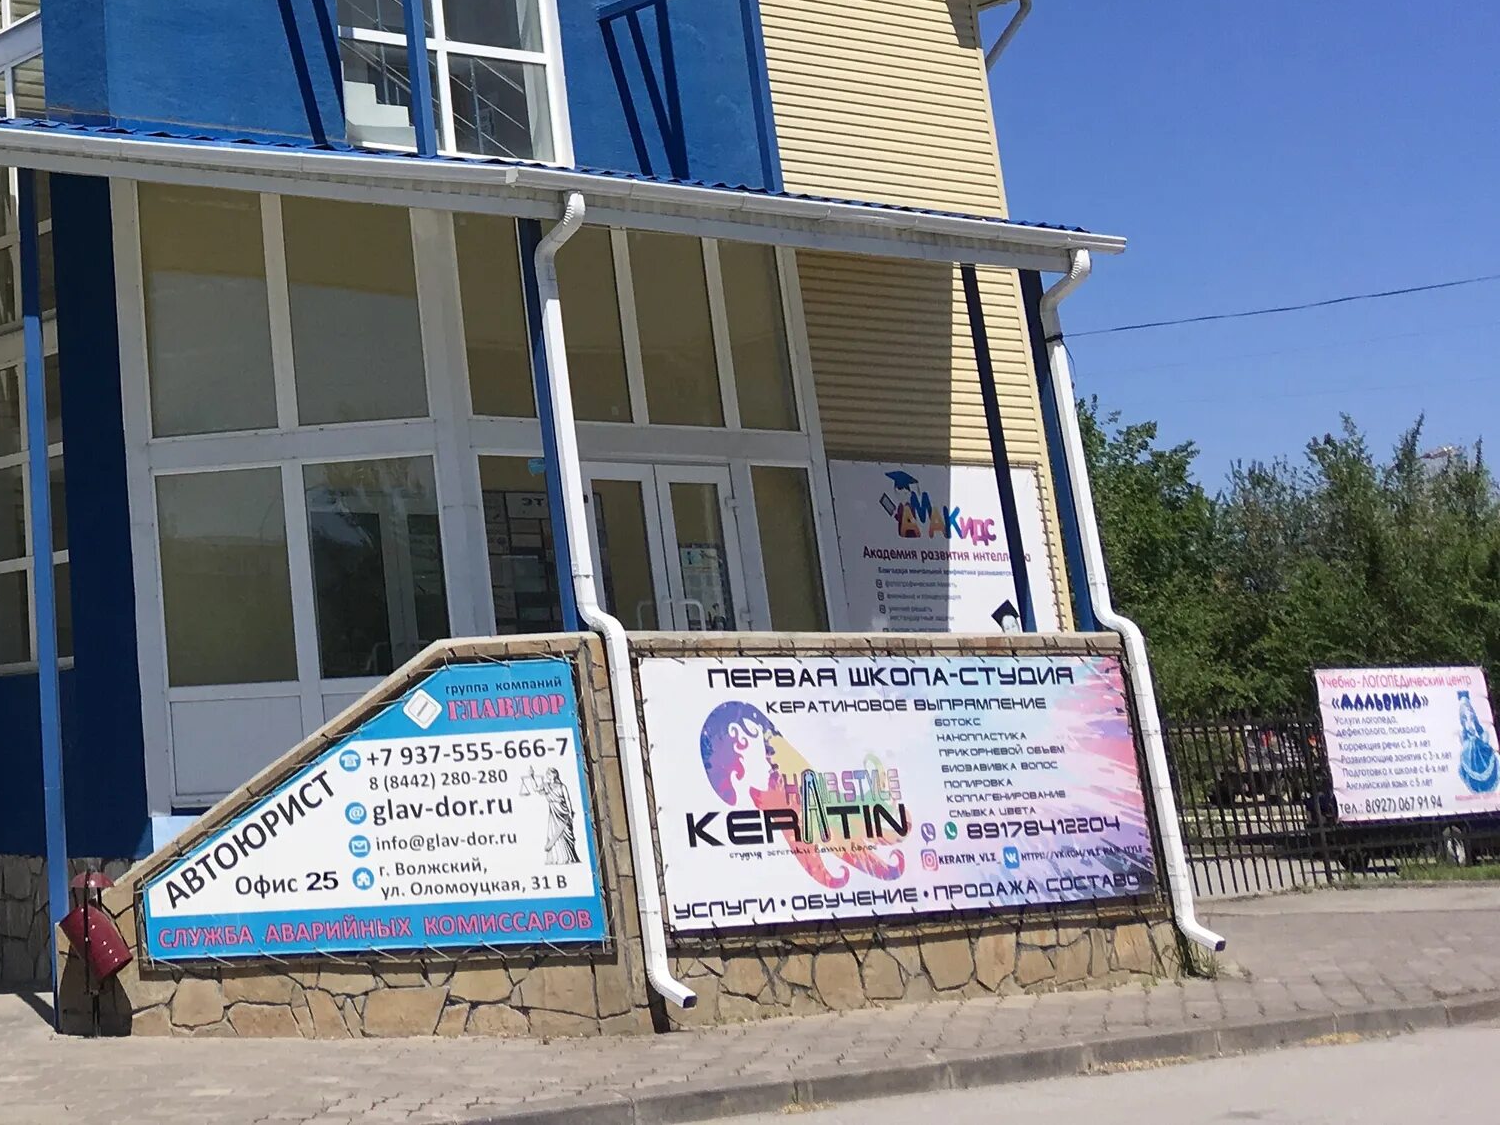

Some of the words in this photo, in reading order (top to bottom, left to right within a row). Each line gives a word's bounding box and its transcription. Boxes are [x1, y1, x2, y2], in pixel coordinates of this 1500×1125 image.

[863, 546, 918, 561] Академия
[921, 550, 970, 563] развития
[445, 684, 489, 696] группа
[496, 676, 562, 691] компаний
[707, 668, 838, 688] ПЕРВАЯ
[849, 666, 1074, 687] ШКОЛА-СТУДИЯ
[447, 693, 566, 721] ГЛАВДОР
[766, 700, 907, 713] КЕРАТИНОВОЕ
[914, 697, 1047, 711] ВЫПРЯМЛЕНИЕ
[934, 718, 981, 727] БОТОКС
[936, 732, 1027, 742] НАНОПЛАСТИКА
[367, 748, 392, 767] +7
[400, 737, 568, 765] 937-555-666-7
[938, 744, 1023, 757] ПРИКОРНЕВОЙ
[1026, 745, 1065, 754] ОБЪЕМ
[941, 763, 1017, 773] БИОЗАВИВКА
[1021, 761, 1059, 770] ВОЛОС
[369, 777, 379, 790] 8
[383, 773, 436, 792] (8442)
[442, 769, 508, 786] 280-280
[944, 779, 1013, 789] ПОЛИРОВКА
[946, 790, 1066, 803] КОЛЛАГЕНИРОВАНИЕ
[1398, 796, 1414, 811] 067
[372, 795, 513, 826] glav-dor.ru
[685, 769, 910, 848] KERATIN
[949, 809, 996, 818] СМЫВКА
[999, 806, 1037, 816] ЦВЕТА
[966, 815, 1121, 840] 89178412204
[165, 770, 334, 909] АВТОЮРИСТ
[376, 831, 517, 852] info@glav-dor.ru
[379, 866, 390, 877] г.
[395, 858, 488, 876] Волжский,
[235, 875, 298, 899] Офис
[305, 871, 339, 891] 25
[381, 885, 405, 900] ул.
[410, 878, 526, 897] Оломоуцкая,
[531, 876, 551, 890] 31
[673, 897, 776, 920] УСЛУГИ
[792, 887, 919, 910] ОБУЧЕНИЕ
[933, 878, 1039, 901] ПРОДАЖА
[158, 925, 253, 948] СЛУЖБА
[265, 914, 413, 944] АВАРИЙНЫХ
[423, 909, 593, 937] КОМИССАРОВ
